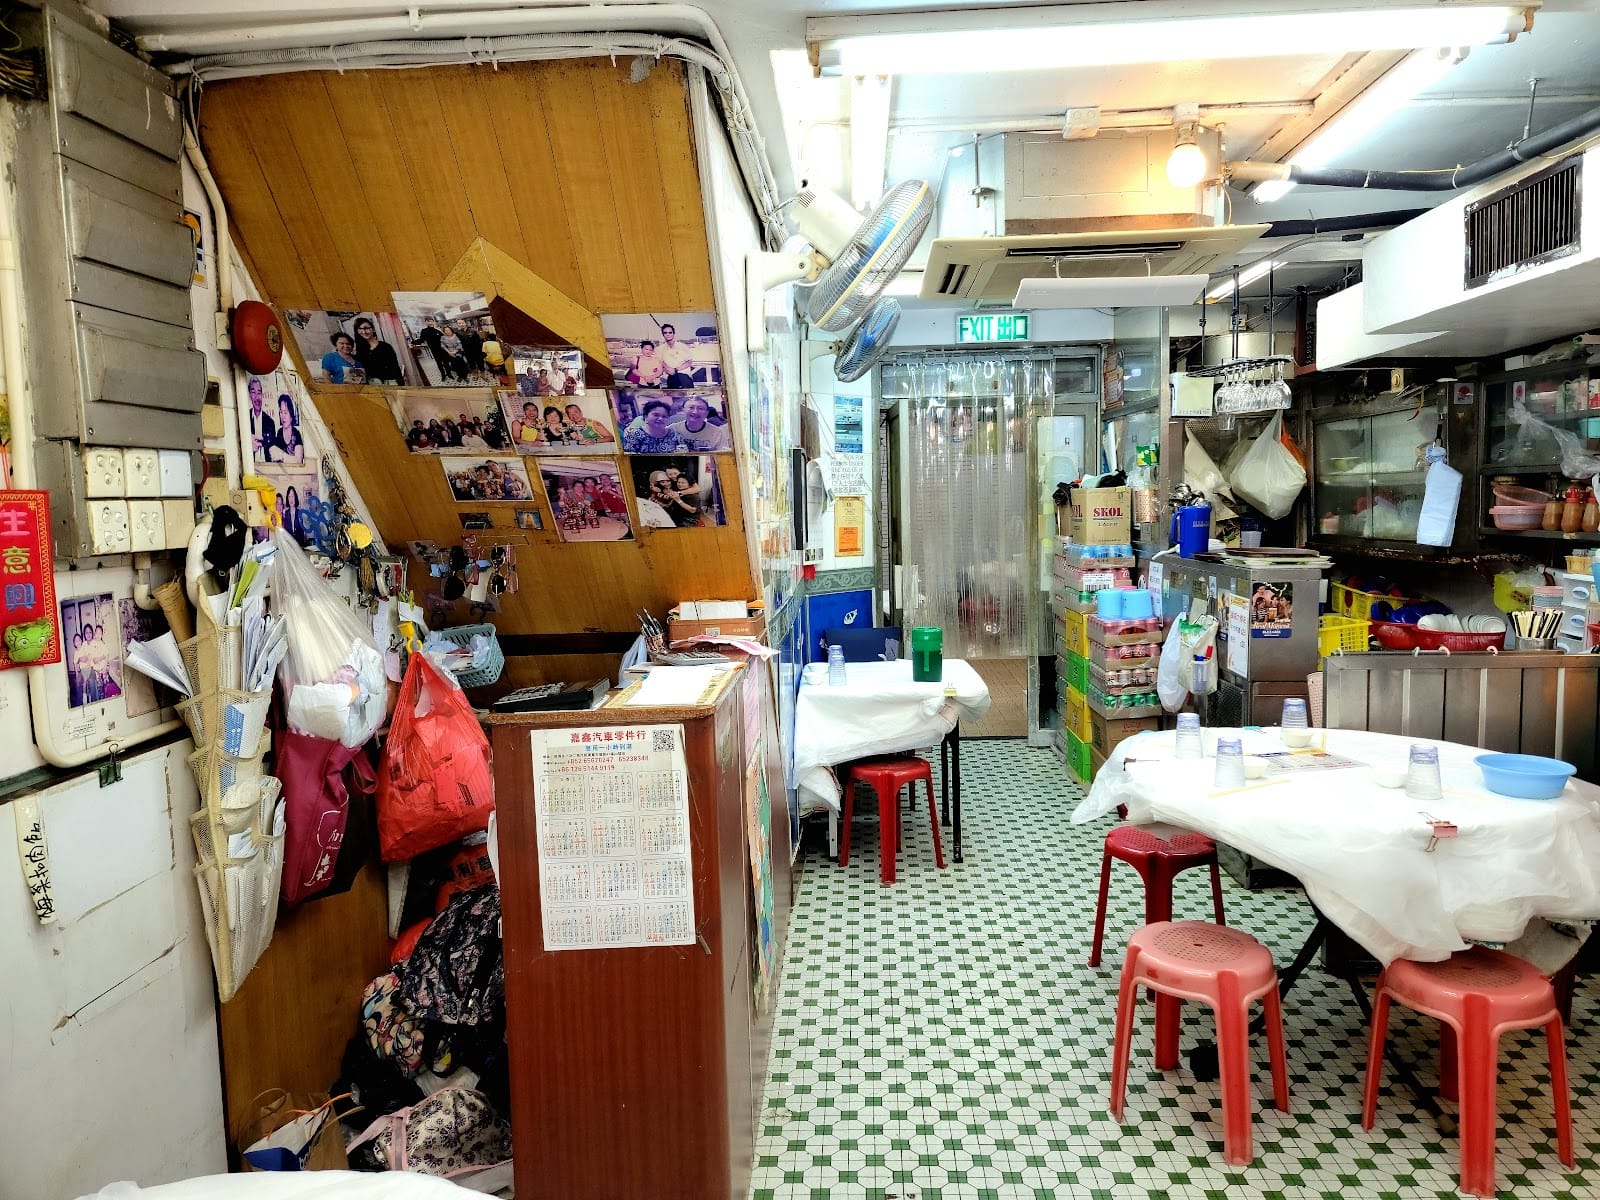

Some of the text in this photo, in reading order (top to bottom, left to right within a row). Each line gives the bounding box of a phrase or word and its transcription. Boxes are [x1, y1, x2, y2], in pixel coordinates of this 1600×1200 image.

[960, 316, 1028, 341] EXIT 出口
[1093, 507, 1123, 517] SKOL
[570, 730, 646, 743] 嘉鑫汽車零件行
